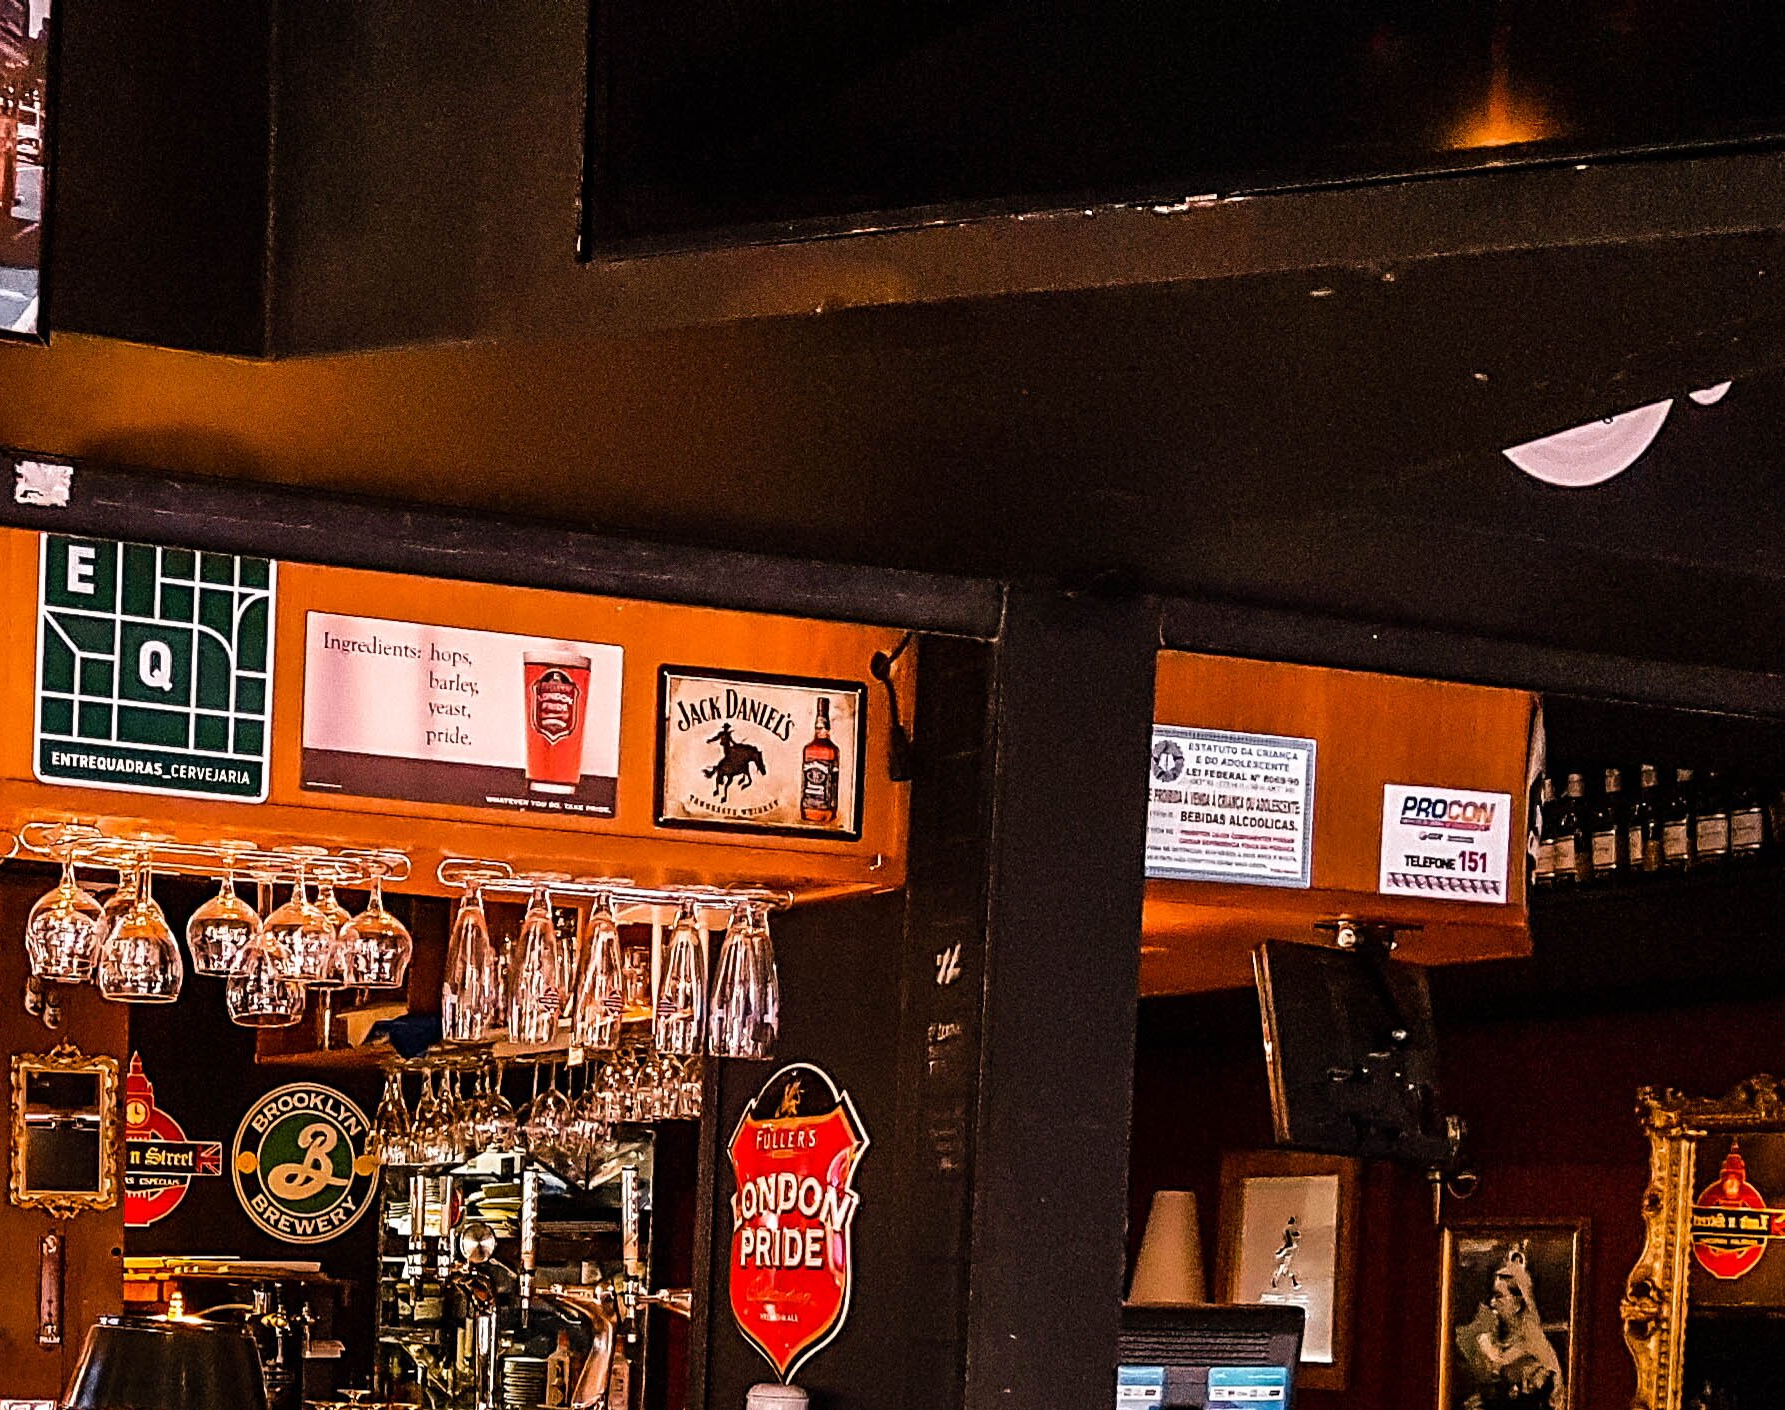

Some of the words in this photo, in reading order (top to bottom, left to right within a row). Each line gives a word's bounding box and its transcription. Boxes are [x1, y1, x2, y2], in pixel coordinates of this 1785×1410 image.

[67, 544, 95, 595] E
[324, 631, 422, 659] Ingredients:
[430, 642, 473, 668] hops,
[139, 640, 173, 692] Q
[428, 670, 480, 696] barley,
[428, 701, 472, 719] yeast,
[677, 696, 722, 732] JACK
[426, 727, 472, 746] pride.
[1188, 742, 1238, 755] ESTATUTO
[1186, 767, 1201, 777] LEI
[1205, 769, 1247, 782] FEDERAL
[1180, 810, 1226, 825] BEBIDAS
[1401, 795, 1496, 823] PROCON
[1404, 854, 1456, 871] TELEFONE
[1458, 850, 1488, 873] 151
[251, 1092, 363, 1137] BROOKLYN
[144, 1146, 194, 1167] Street
[251, 1193, 357, 1235] BREWERY
[731, 1172, 856, 1233] LONDON
[740, 1226, 825, 1267] PRIDE
